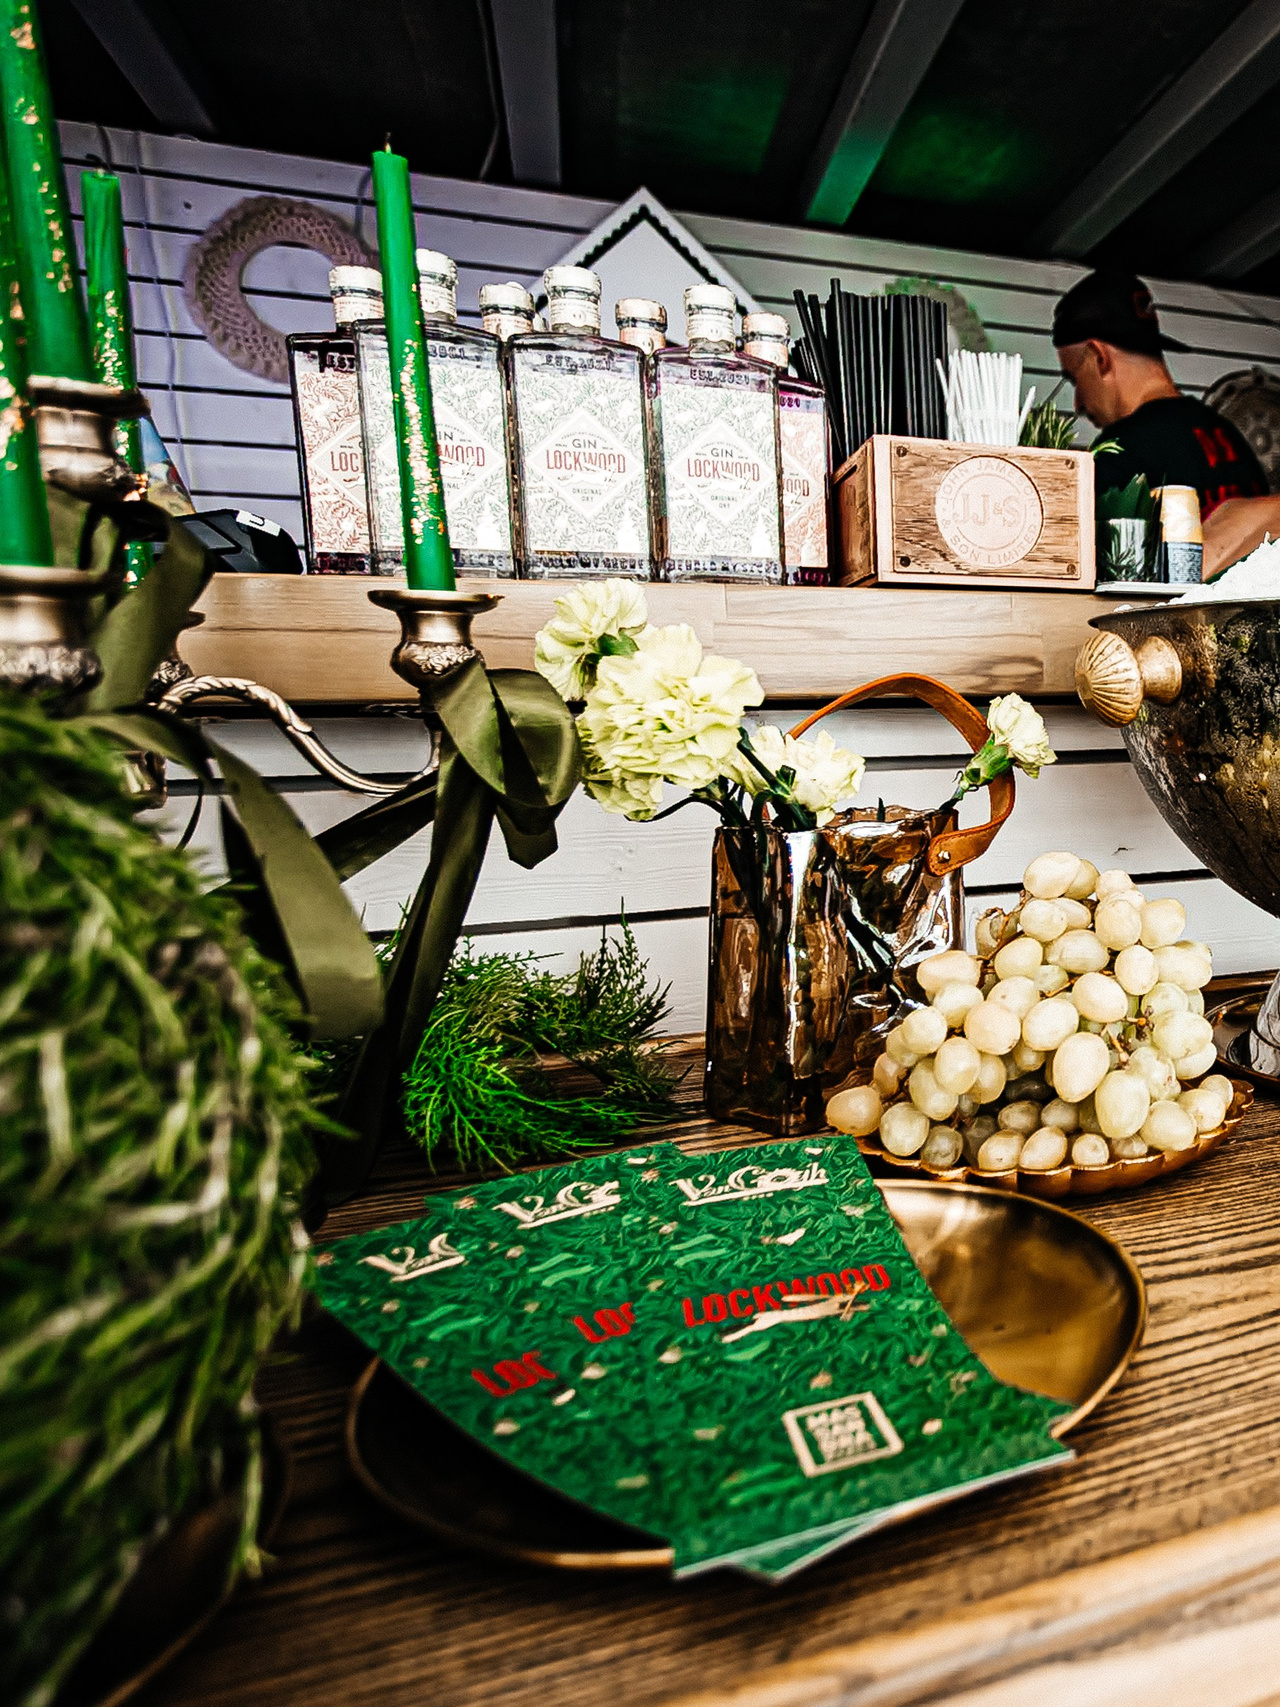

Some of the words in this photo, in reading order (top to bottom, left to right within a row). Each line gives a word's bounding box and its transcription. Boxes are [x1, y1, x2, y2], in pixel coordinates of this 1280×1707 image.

[438, 431, 454, 441] IN
[571, 438, 597, 450] GIN
[546, 449, 626, 474] LOCKWOOD
[711, 447, 734, 458] GIN
[687, 457, 760, 482] LOCKWOOD
[940, 467, 969, 504] JOHN
[977, 459, 1038, 509] JAMESON
[950, 535, 980, 562] SON
[988, 524, 1037, 565] LIMITED
[682, 1263, 891, 1328] LOCKWOOD
